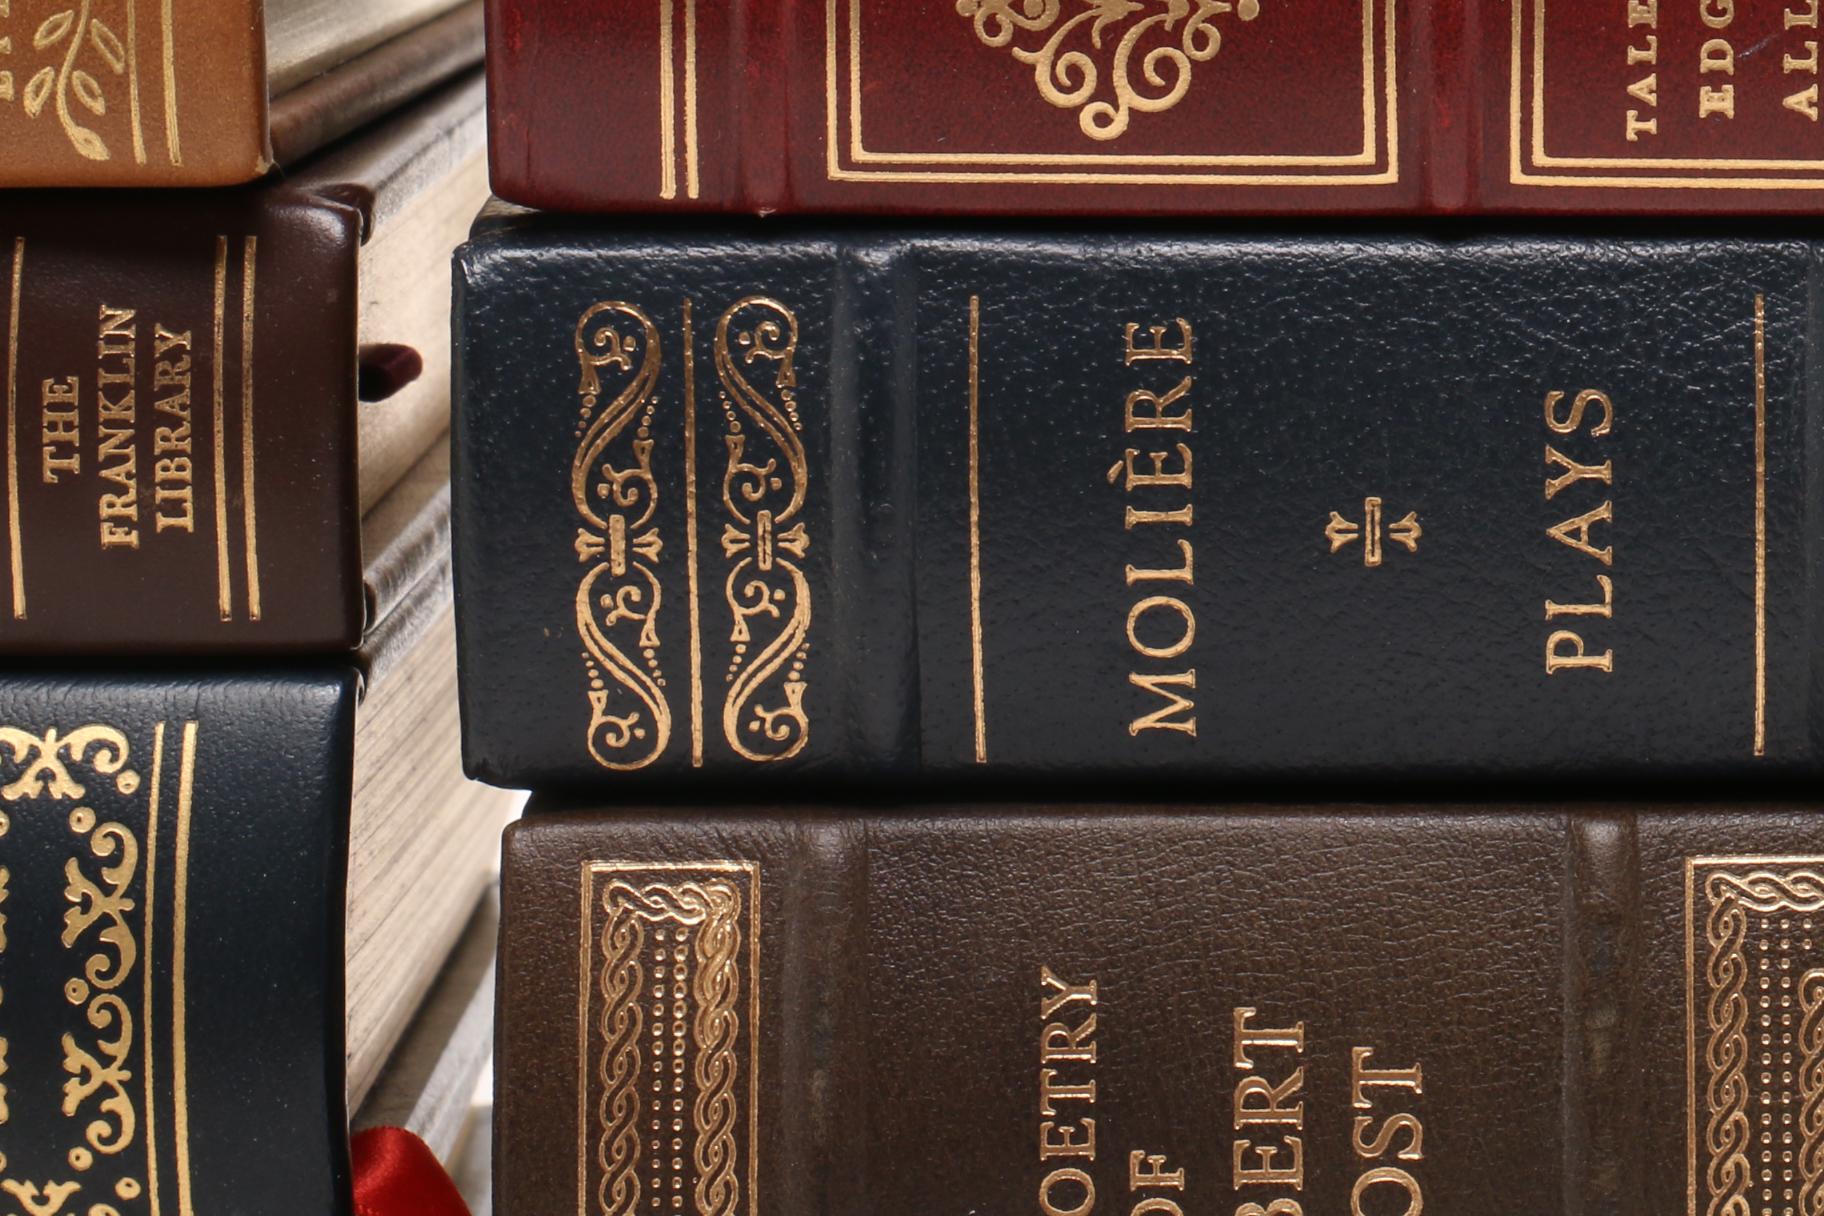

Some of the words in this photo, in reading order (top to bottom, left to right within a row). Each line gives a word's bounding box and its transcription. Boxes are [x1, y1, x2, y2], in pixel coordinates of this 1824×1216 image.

[42, 375, 81, 484] THE
[97, 304, 140, 550] FRANKLIN
[154, 322, 194, 534] LIBRARY
[1106, 317, 1197, 738] MOLIÈRE
[1543, 387, 1614, 675] PLAYS
